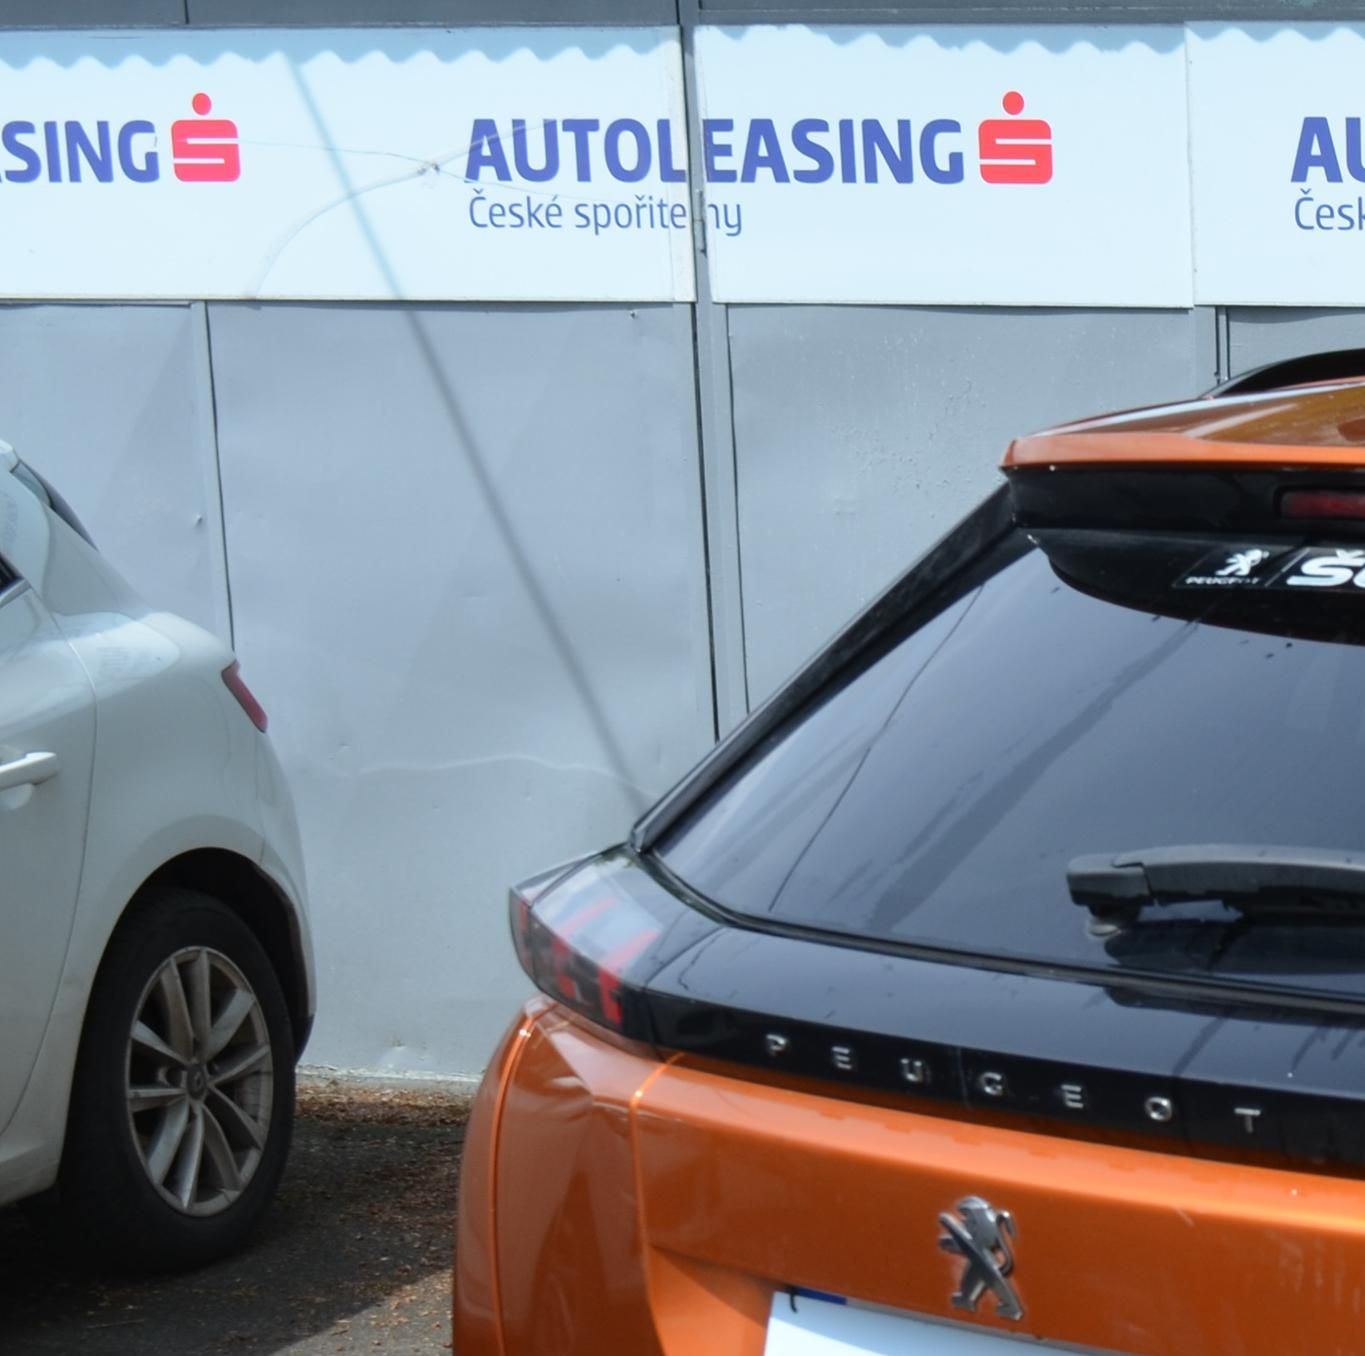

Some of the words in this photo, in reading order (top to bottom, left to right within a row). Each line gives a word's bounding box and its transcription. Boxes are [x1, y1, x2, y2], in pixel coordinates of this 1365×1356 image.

[0, 120, 160, 184] SING
[464, 118, 965, 185] AUTOLEASING
[469, 189, 563, 229] České
[575, 194, 743, 237] spořiteny
[766, 1033, 1261, 1133] PEUGEOT
